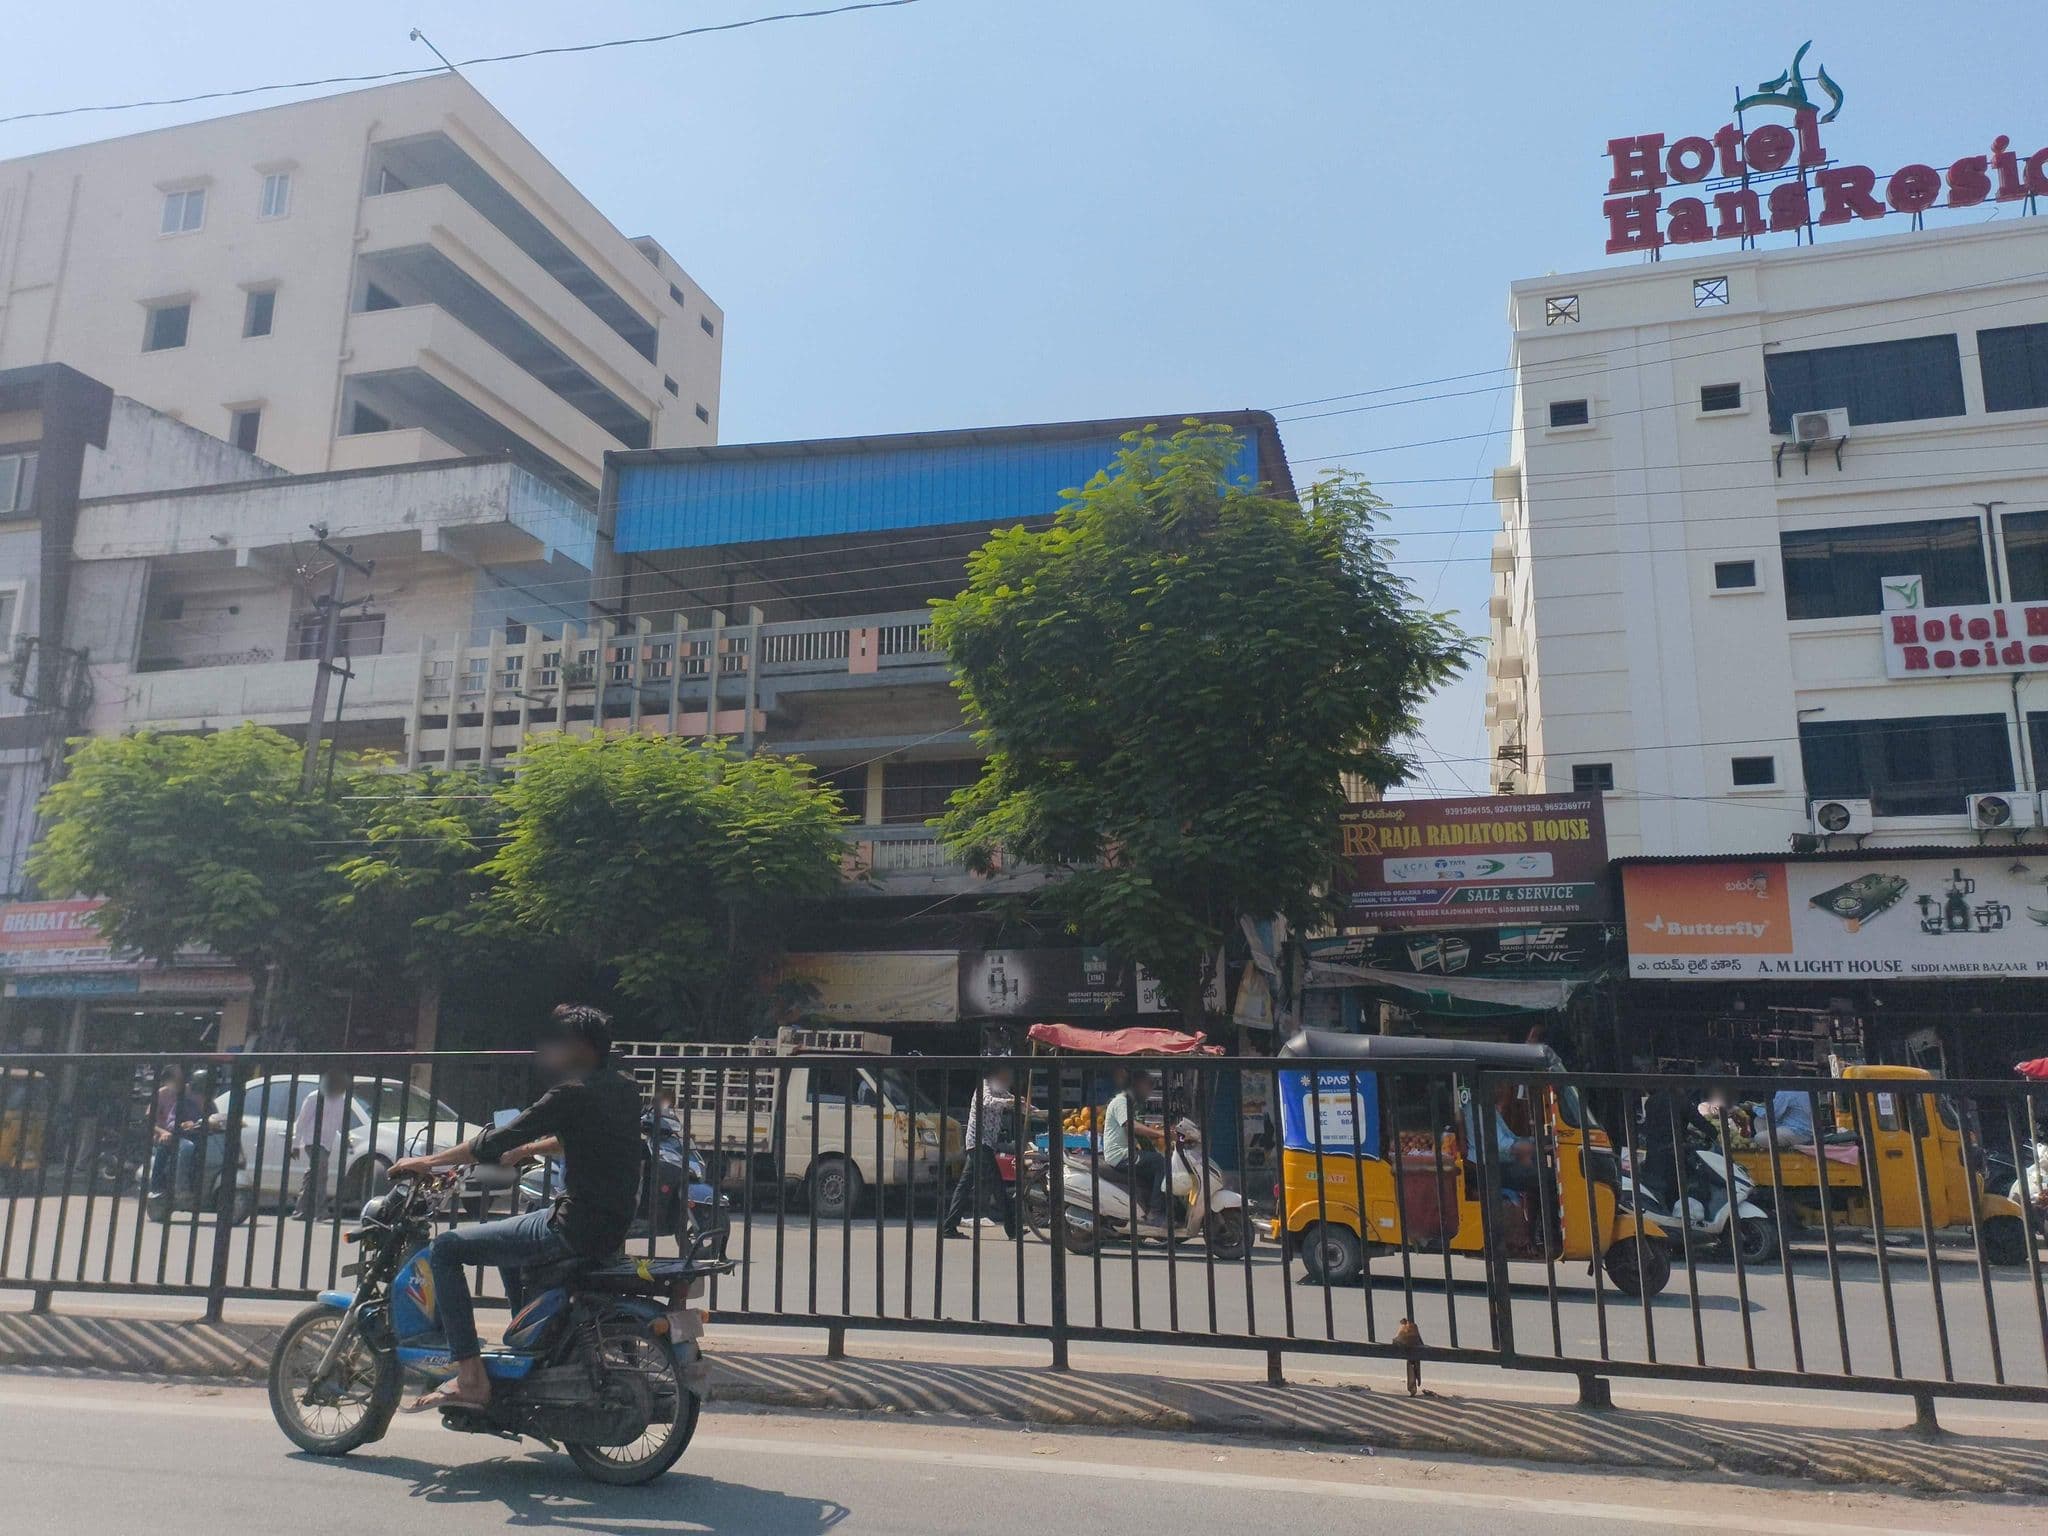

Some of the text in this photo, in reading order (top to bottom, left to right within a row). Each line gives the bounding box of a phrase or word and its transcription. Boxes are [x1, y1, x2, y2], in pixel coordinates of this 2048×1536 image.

[1607, 107, 1826, 194] Hotel
[1891, 608, 2008, 644] Hotel
[1380, 825, 1422, 850] RAJA
[1426, 822, 1527, 846] RADIATORS
[1532, 819, 1590, 841] HOUSE
[1468, 886, 1573, 902] SALE & SERVICE
[1667, 921, 1766, 938] Butterfly
[1481, 950, 1581, 965] SONIC
[1794, 960, 1844, 973] LIGHT
[1848, 959, 1903, 973] HOUSE
[1911, 963, 1939, 972] SIDDI
[1942, 963, 1980, 972] AMBER
[1983, 962, 2028, 972] BAZAAR
